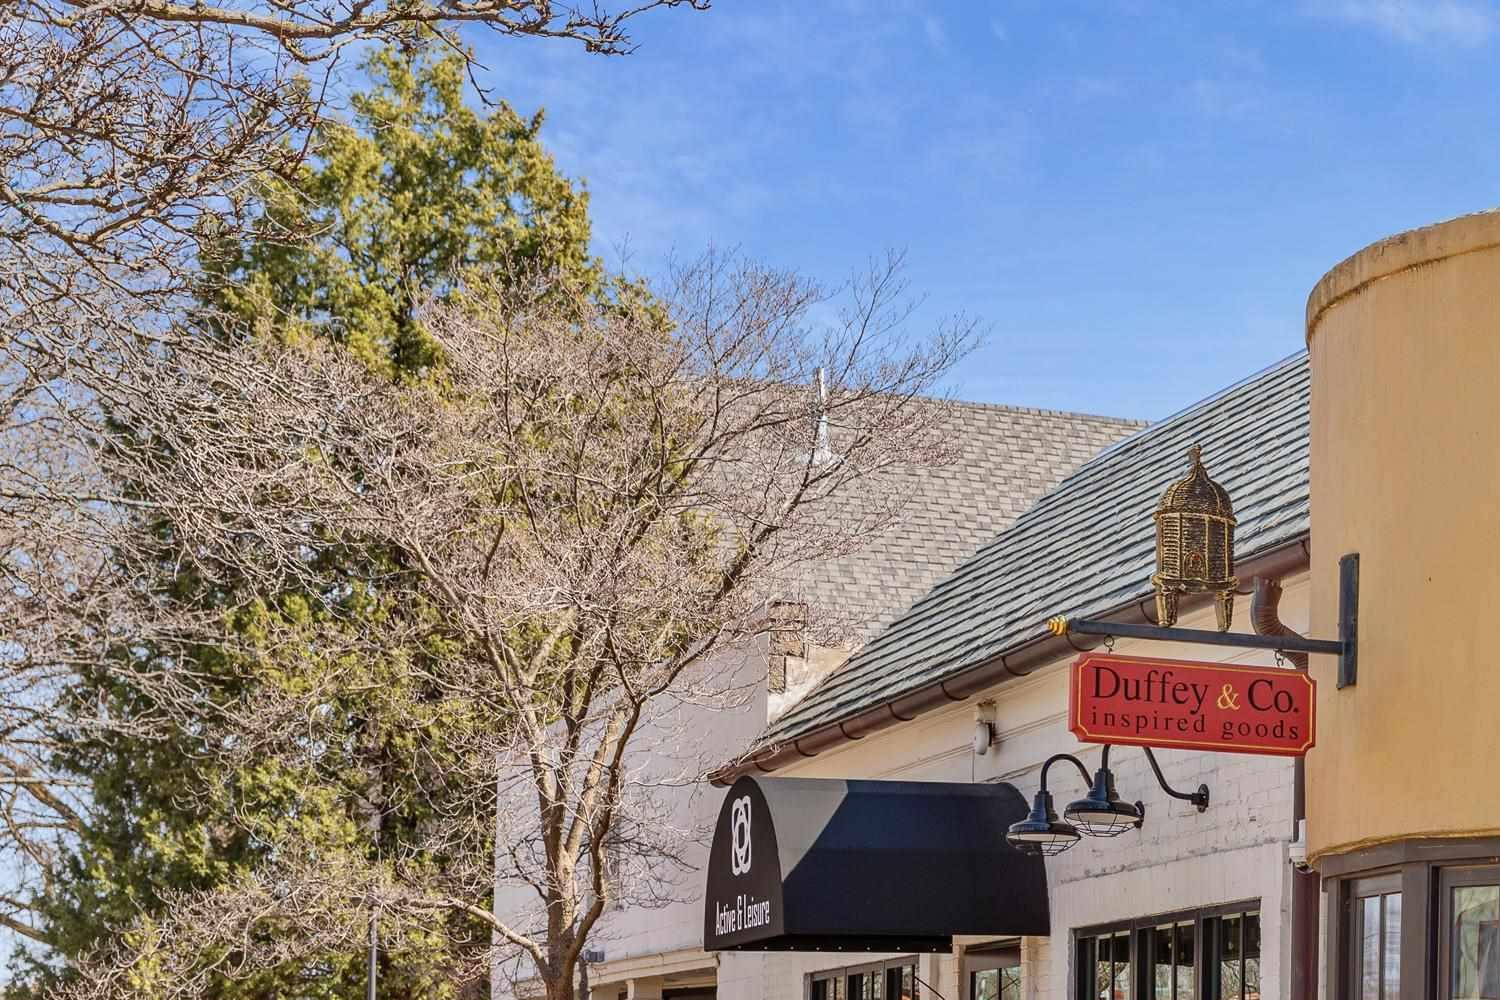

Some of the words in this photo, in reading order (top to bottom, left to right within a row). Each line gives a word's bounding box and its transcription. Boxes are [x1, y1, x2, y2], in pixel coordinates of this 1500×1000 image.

[1092, 666, 1208, 715] Duffey
[1216, 683, 1240, 711] &
[1247, 679, 1300, 713] Co.
[1091, 706, 1206, 733] inspired
[1221, 719, 1299, 740] goods
[715, 901, 736, 936] Active
[737, 895, 743, 930] &
[743, 894, 770, 929] Leisure
